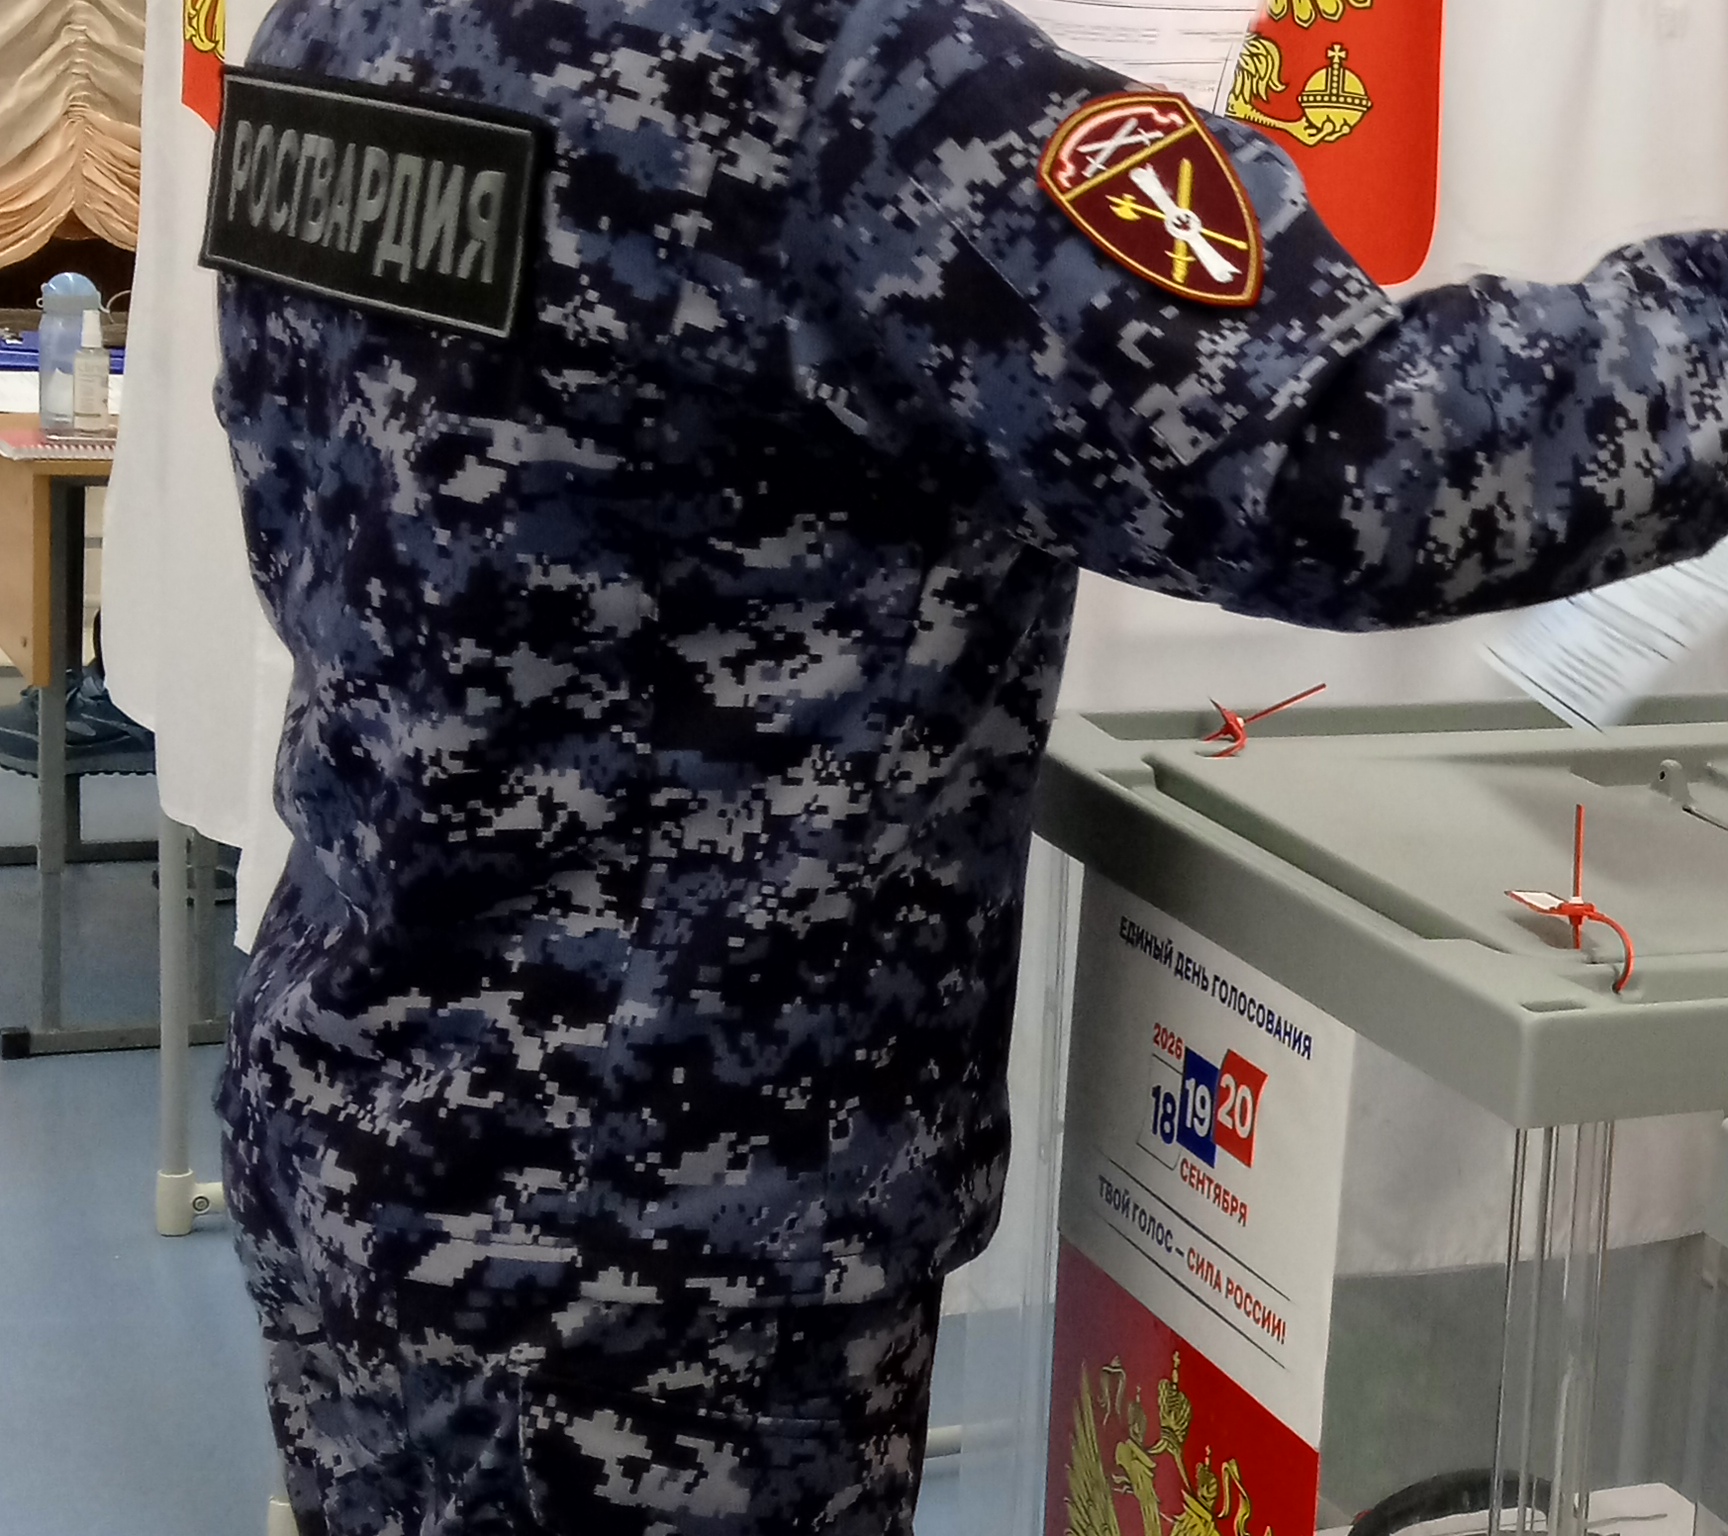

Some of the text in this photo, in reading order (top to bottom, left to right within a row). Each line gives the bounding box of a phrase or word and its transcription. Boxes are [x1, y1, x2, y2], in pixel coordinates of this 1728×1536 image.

[228, 120, 507, 284] РОСГВАРДИЯ
[1119, 915, 1313, 1061] ЕДИНЫЙ ДЕНЬ ГОЛОСОВАНИЯ
[1153, 1022, 1184, 1061] 2026
[1151, 1073, 1254, 1145] 18 19 20
[1179, 1158, 1249, 1227] СЕНТЯБРЯ
[1099, 1174, 1131, 1219] ТВОЙ
[1132, 1201, 1174, 1254] ГОЛОС
[1187, 1247, 1223, 1293] СИЛА
[1226, 1281, 1287, 1344] РОССИИ!
